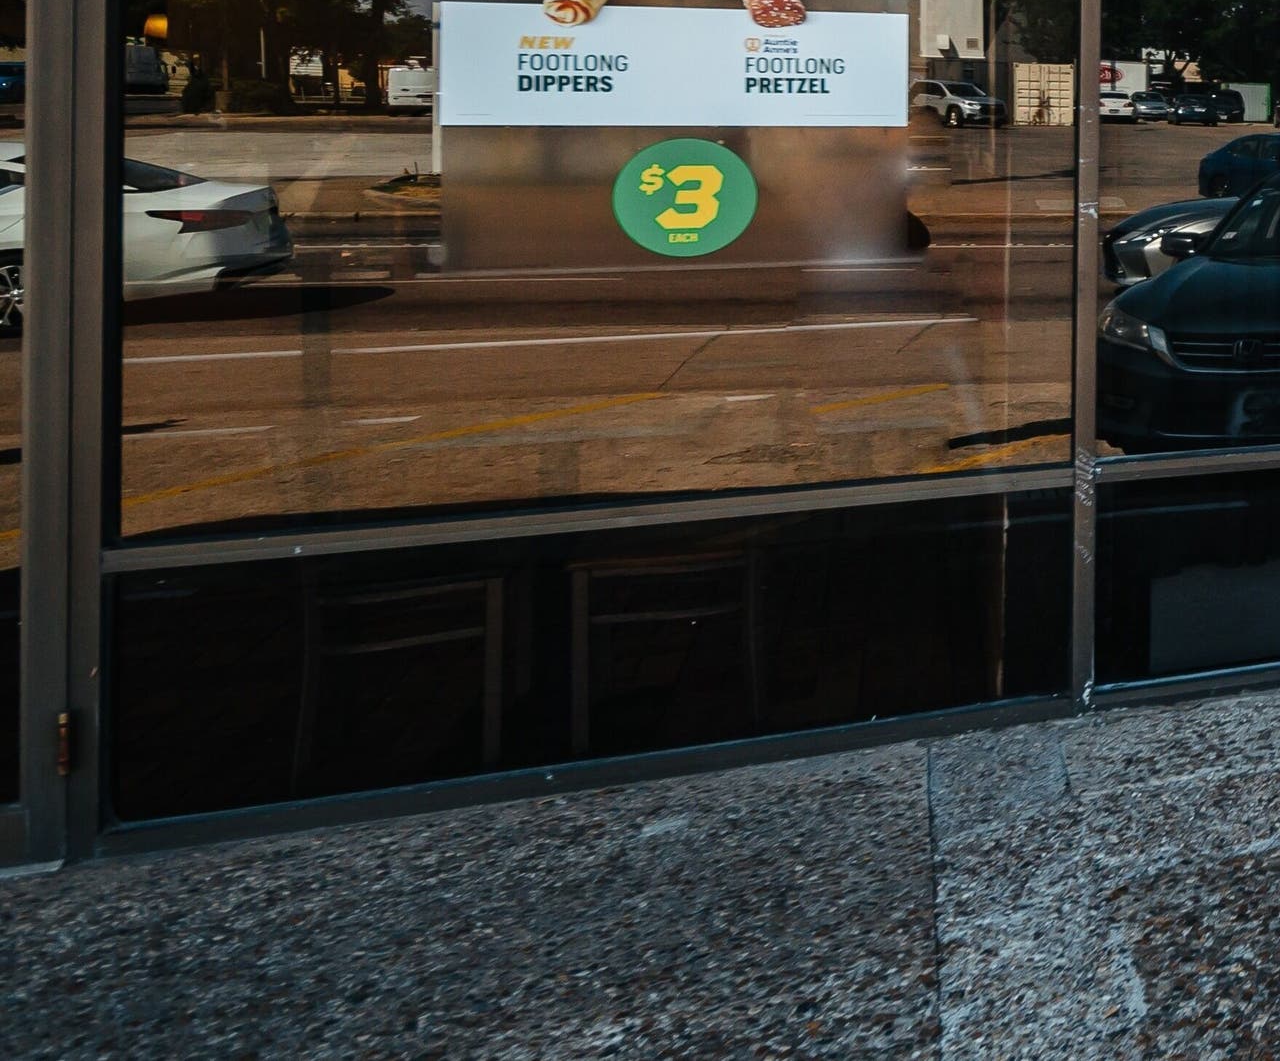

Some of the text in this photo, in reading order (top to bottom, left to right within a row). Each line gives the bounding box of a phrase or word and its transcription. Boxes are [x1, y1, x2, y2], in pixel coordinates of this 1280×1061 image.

[518, 36, 575, 50] NEW
[518, 53, 629, 72] FOOTLONG
[746, 57, 845, 75] FOOTLONG
[518, 75, 613, 93] DIPPERS
[746, 78, 830, 94] PRETZEL
[639, 163, 724, 230] $3
[668, 233, 698, 243] EACH
